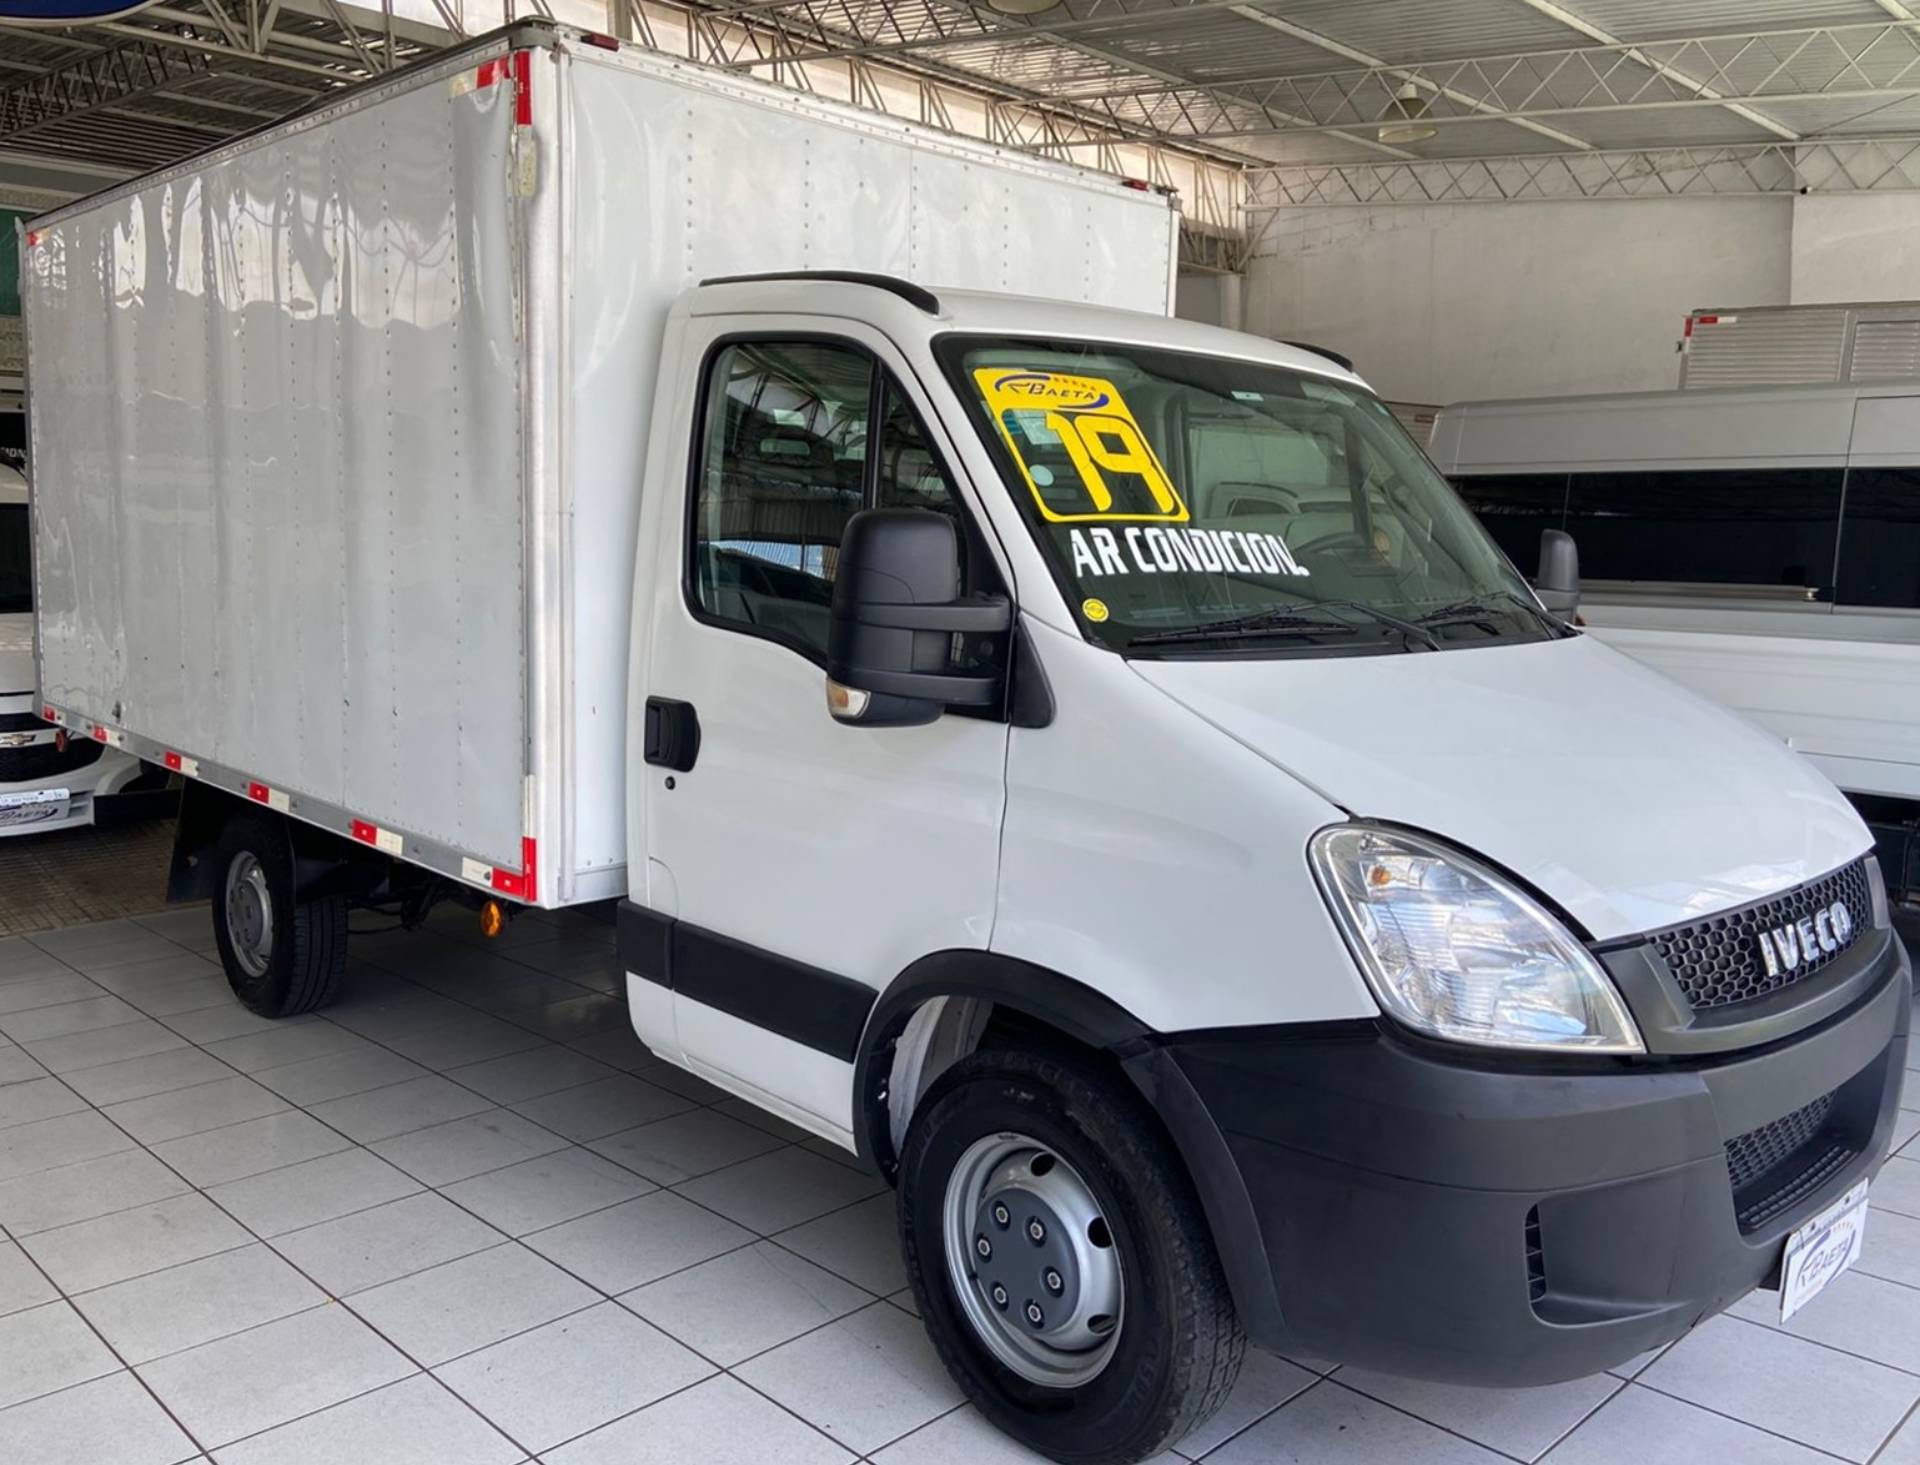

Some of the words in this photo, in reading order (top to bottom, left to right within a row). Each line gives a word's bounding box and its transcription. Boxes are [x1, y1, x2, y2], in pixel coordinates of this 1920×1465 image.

[1027, 382, 1095, 400] BAETA
[1045, 409, 1176, 513] 19
[1070, 527, 1130, 578] AR
[1758, 902, 1850, 977] IVECO
